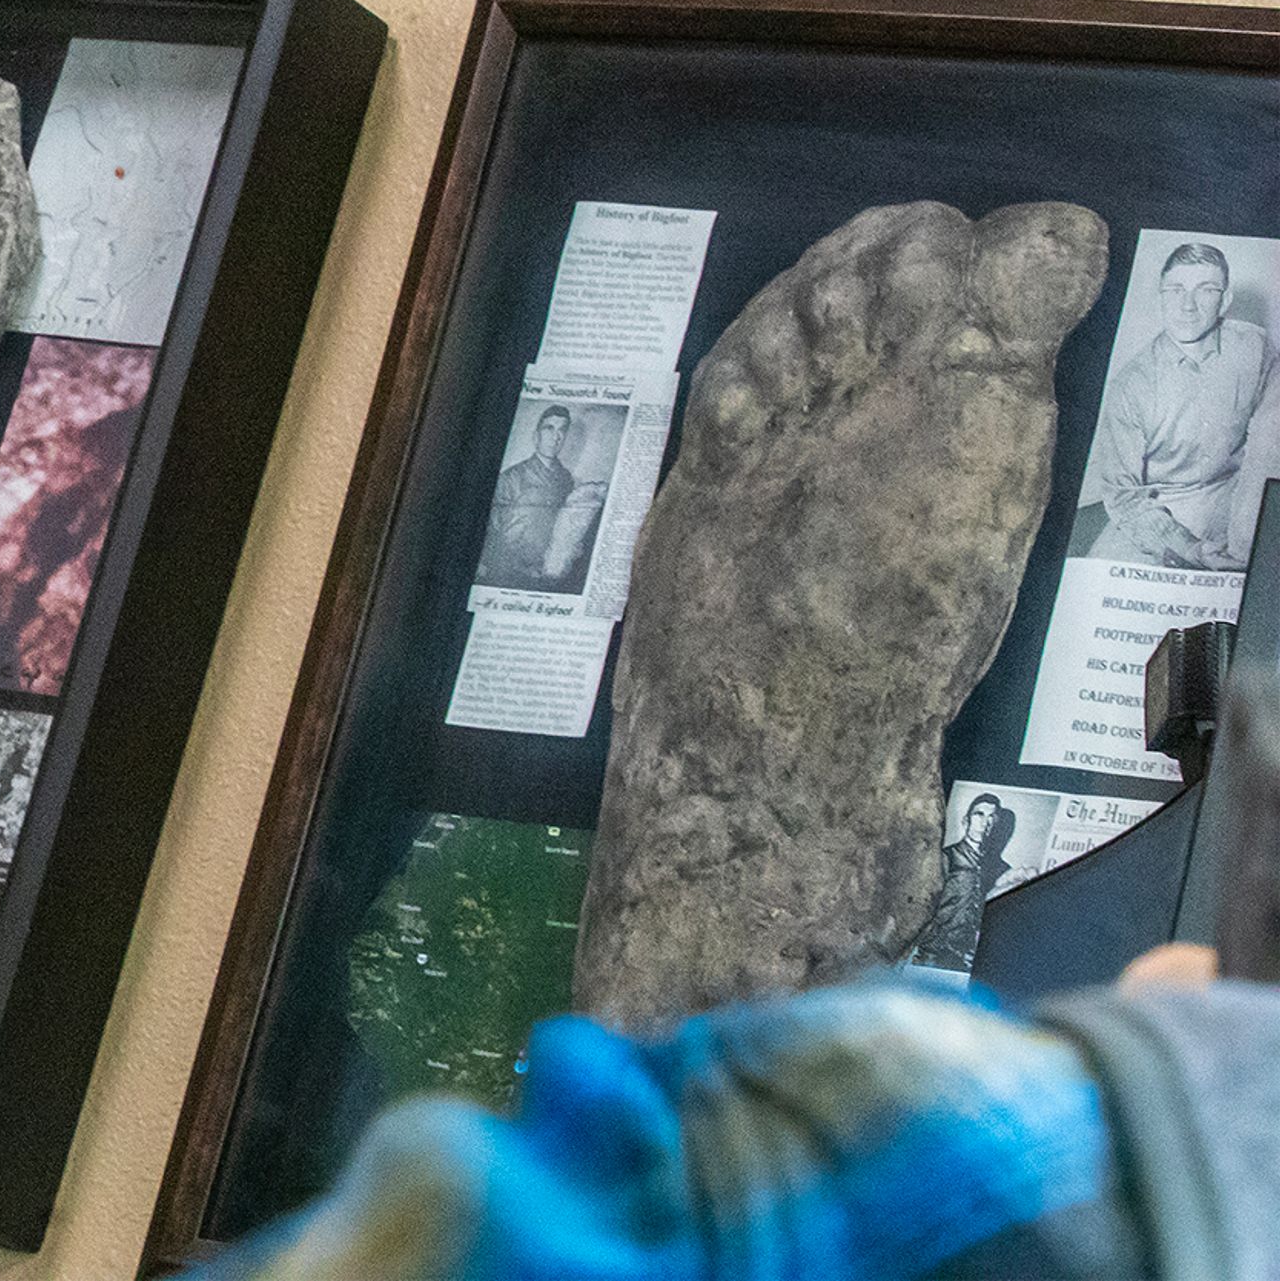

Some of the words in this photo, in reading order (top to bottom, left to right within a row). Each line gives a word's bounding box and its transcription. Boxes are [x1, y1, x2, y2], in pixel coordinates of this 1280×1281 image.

[596, 206, 634, 224] History
[638, 210, 650, 221] of
[651, 211, 690, 225] Bigfoot
[523, 382, 543, 394] New
[548, 384, 598, 398] Sasquatch
[602, 387, 632, 401] found
[1109, 566, 1188, 585] CATSKINNER
[1190, 573, 1229, 588] JERRY
[502, 600, 532, 613] called
[535, 603, 575, 618] Bigfoot
[1101, 596, 1155, 615] HOLDING
[1157, 604, 1190, 616] CAST
[1192, 607, 1209, 617] OF
[1209, 607, 1219, 618] A
[1086, 658, 1107, 670] HIS
[1109, 660, 1144, 677] CATE
[1078, 689, 1143, 707] CALIFORN
[1071, 720, 1108, 734] ROAD
[1110, 724, 1143, 740] CONS
[1063, 750, 1078, 762] IN
[1079, 754, 1138, 771] OCTOBER
[1140, 760, 1157, 772] OF
[1066, 800, 1097, 823] The
